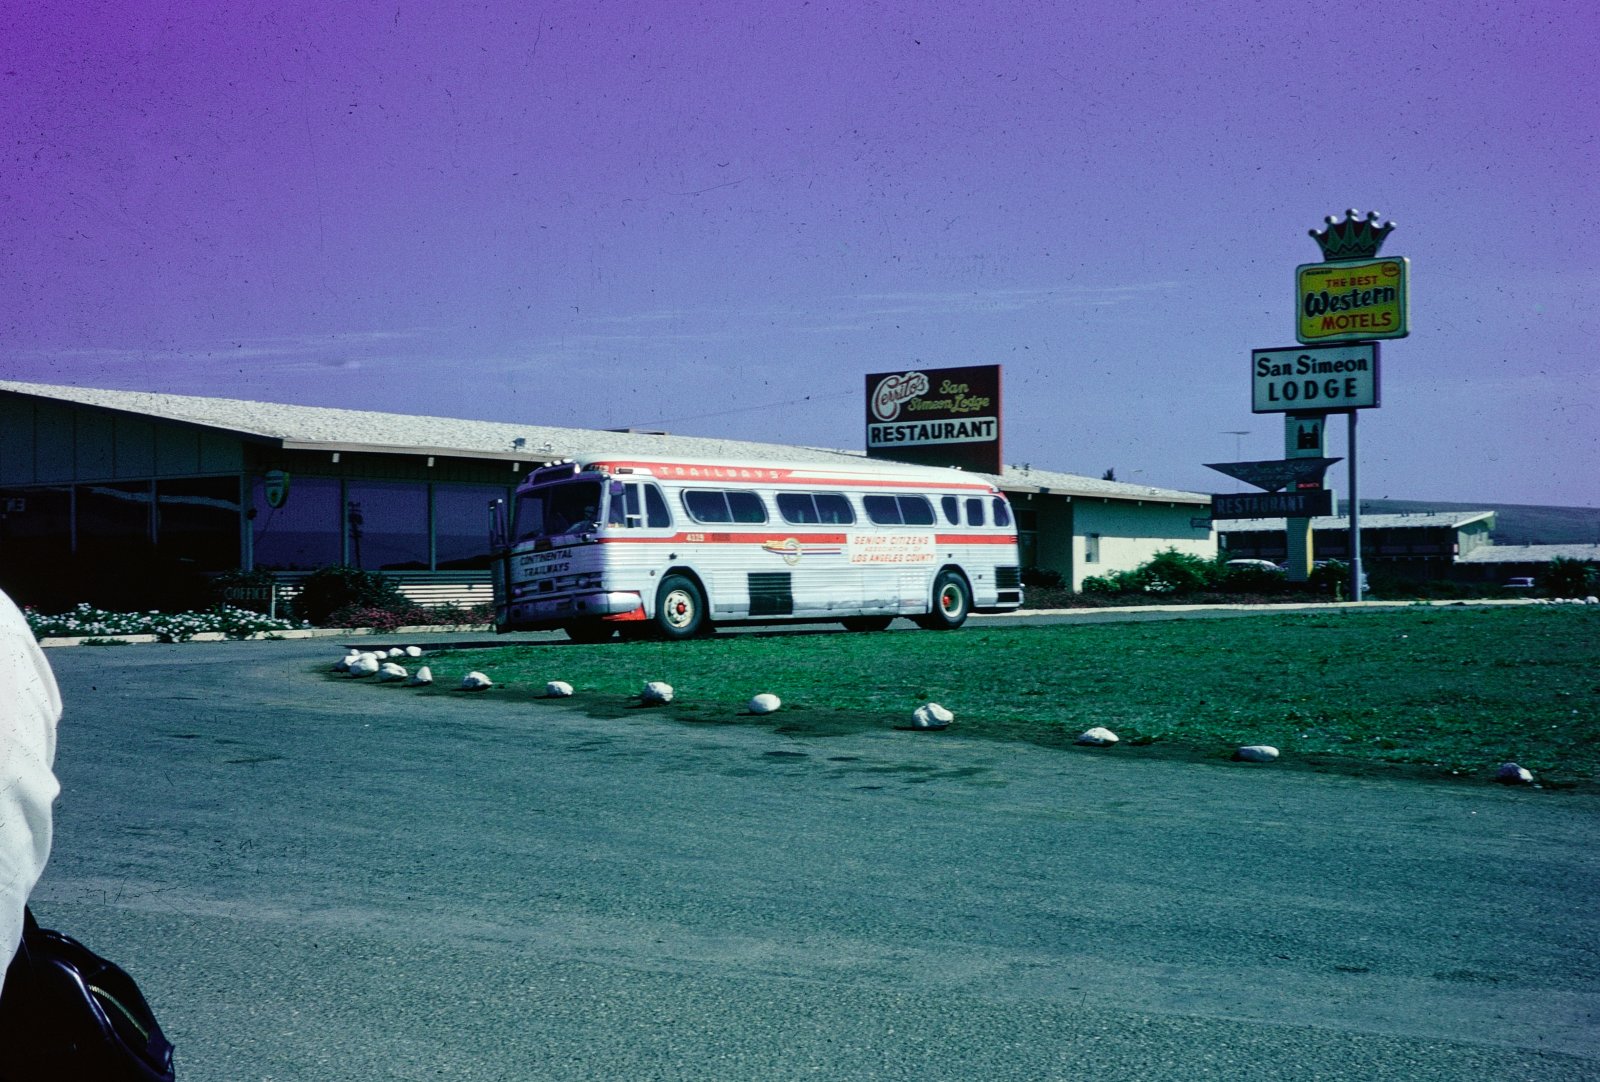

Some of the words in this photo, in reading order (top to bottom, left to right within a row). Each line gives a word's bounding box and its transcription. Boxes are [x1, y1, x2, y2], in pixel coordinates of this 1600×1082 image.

[1325, 278, 1346, 287] THE
[1350, 275, 1378, 286] BEST
[1305, 286, 1395, 317] Western
[1321, 312, 1392, 331] MOTELS
[1257, 357, 1292, 377] San
[1296, 354, 1368, 376] Simeon
[939, 380, 969, 394] San
[1268, 377, 1357, 402] LODGE
[907, 397, 952, 411] Simeon
[950, 394, 990, 413] Lodge
[871, 420, 994, 443] RESTAURANT
[659, 467, 779, 479] TRAILWAYS
[1216, 495, 1305, 514] RESTAURANT
[854, 536, 886, 545] SENIOR
[890, 536, 929, 545] CITIZENS
[520, 549, 573, 566] CONTINENTAL
[852, 554, 868, 563] LOS
[869, 553, 904, 562] ANGELES
[905, 553, 935, 562] COUNTY
[524, 561, 570, 577] TRAILWAYS
